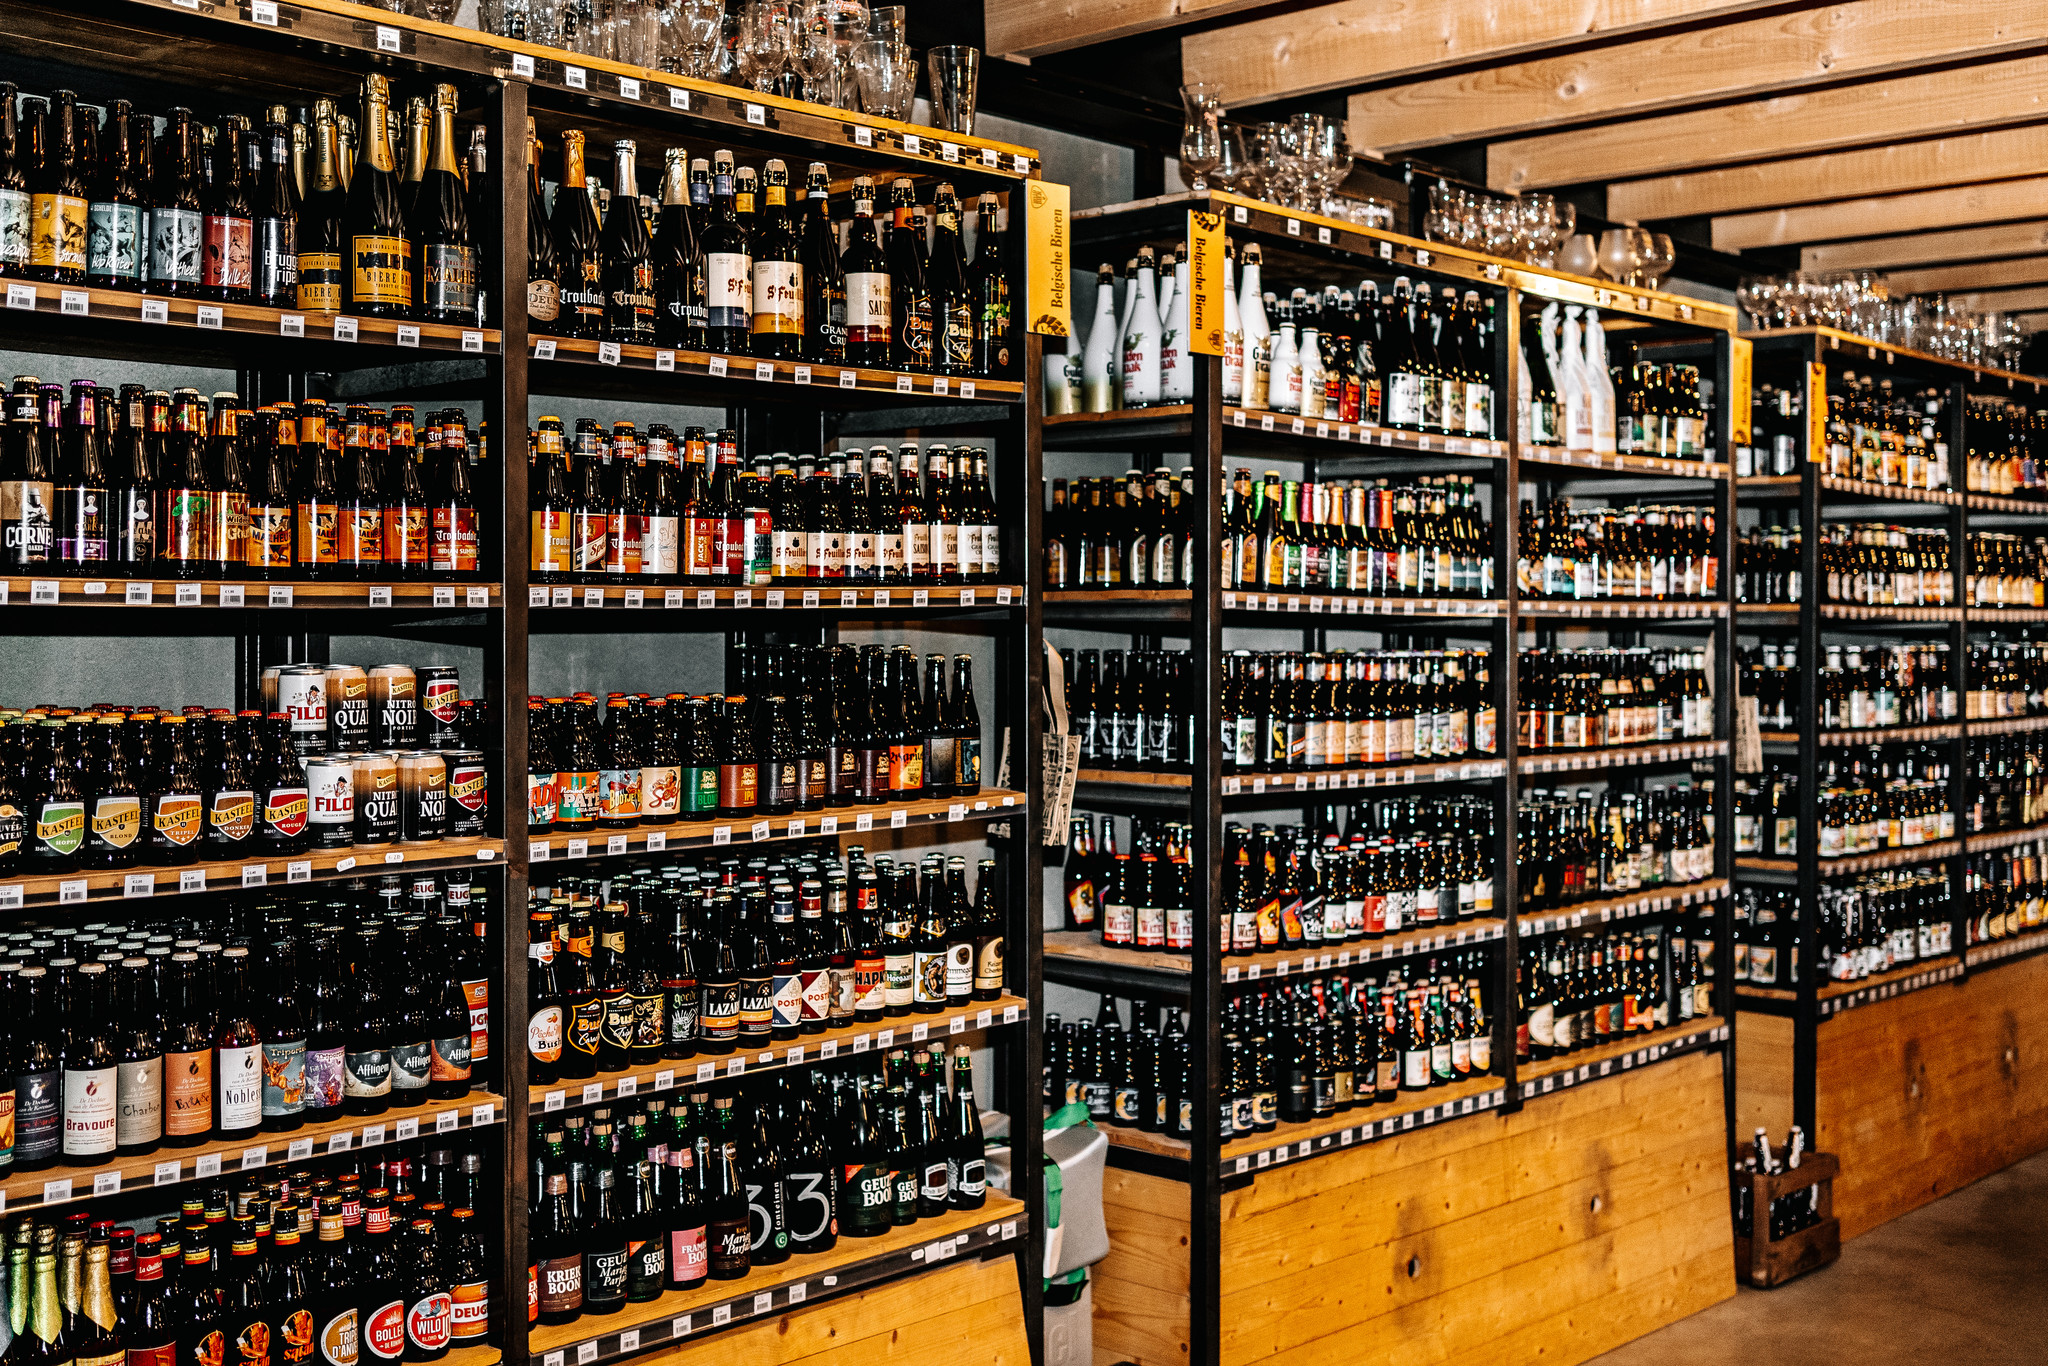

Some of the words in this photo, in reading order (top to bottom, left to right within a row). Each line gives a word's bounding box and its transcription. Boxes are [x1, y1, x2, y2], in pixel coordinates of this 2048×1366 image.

[1050, 208, 1063, 249] Bieren
[1195, 237, 1206, 291] Belgische
[366, 270, 397, 284] BIÈRE
[1050, 252, 1063, 309] Belgische
[1195, 291, 1206, 330] Bieren
[17, 406, 39, 417] CORNET
[744, 791, 754, 800] IPA
[158, 808, 200, 828] KASTEEL
[214, 803, 254, 823] KASTEEL
[268, 799, 308, 821] KASTEEL
[41, 814, 84, 838] KASTEEL
[96, 811, 139, 830] KASTEEL
[357, 1063, 389, 1076] Affligem
[66, 1117, 115, 1132] Bravoure
[790, 1173, 830, 1242] 3
[548, 1278, 581, 1295] BOON
[417, 1318, 441, 1335] WILD
[284, 1342, 314, 1362] satan
